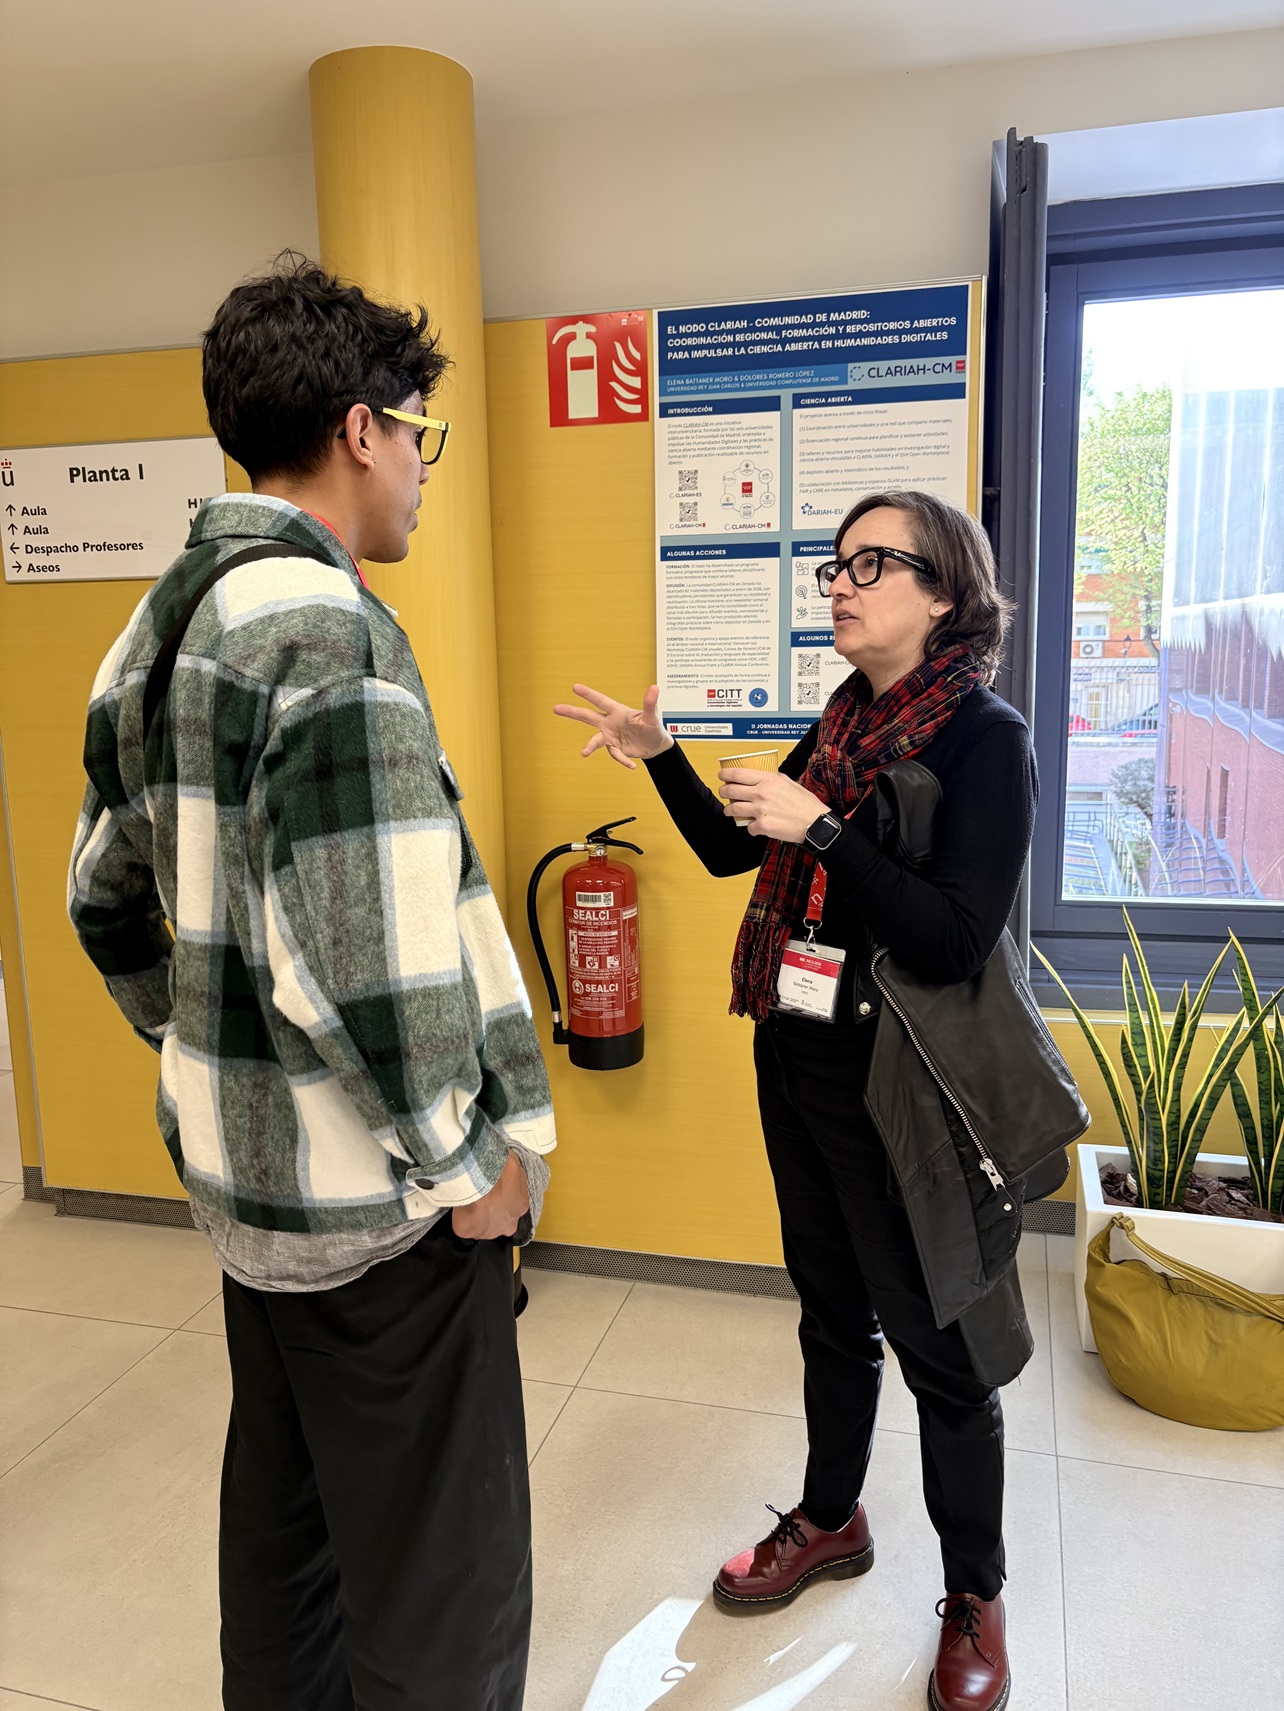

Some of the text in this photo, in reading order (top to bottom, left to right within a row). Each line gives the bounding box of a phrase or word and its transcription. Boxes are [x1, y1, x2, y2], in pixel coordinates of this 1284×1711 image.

[668, 326, 677, 334] EL
[679, 324, 706, 334] NODO
[708, 320, 747, 331] CLARIAH
[755, 314, 814, 327] COMUNIDAD
[816, 313, 827, 322] DE
[830, 310, 870, 321] MADRID:
[668, 317, 957, 347] COORDINACIÓN REGIONAL, FORMACIÓN Y REPOSITORIOS ABIERTOS
[668, 331, 948, 360] PARA IMPULSAR LA CIENCIA ABIERTA EN HUMANIDADES DIGITALES
[868, 362, 952, 379] CLARIAH-CM
[668, 406, 713, 414] INTRODUCCIÓN
[69, 465, 130, 483] Planta
[21, 506, 47, 517] Aula
[23, 525, 49, 535] Aula
[25, 540, 144, 556] Despacho Profesores
[27, 563, 60, 573] Aseos
[717, 689, 742, 698] CITT
[573, 909, 609, 920] SEALCI
[585, 983, 618, 993] SEALCI
